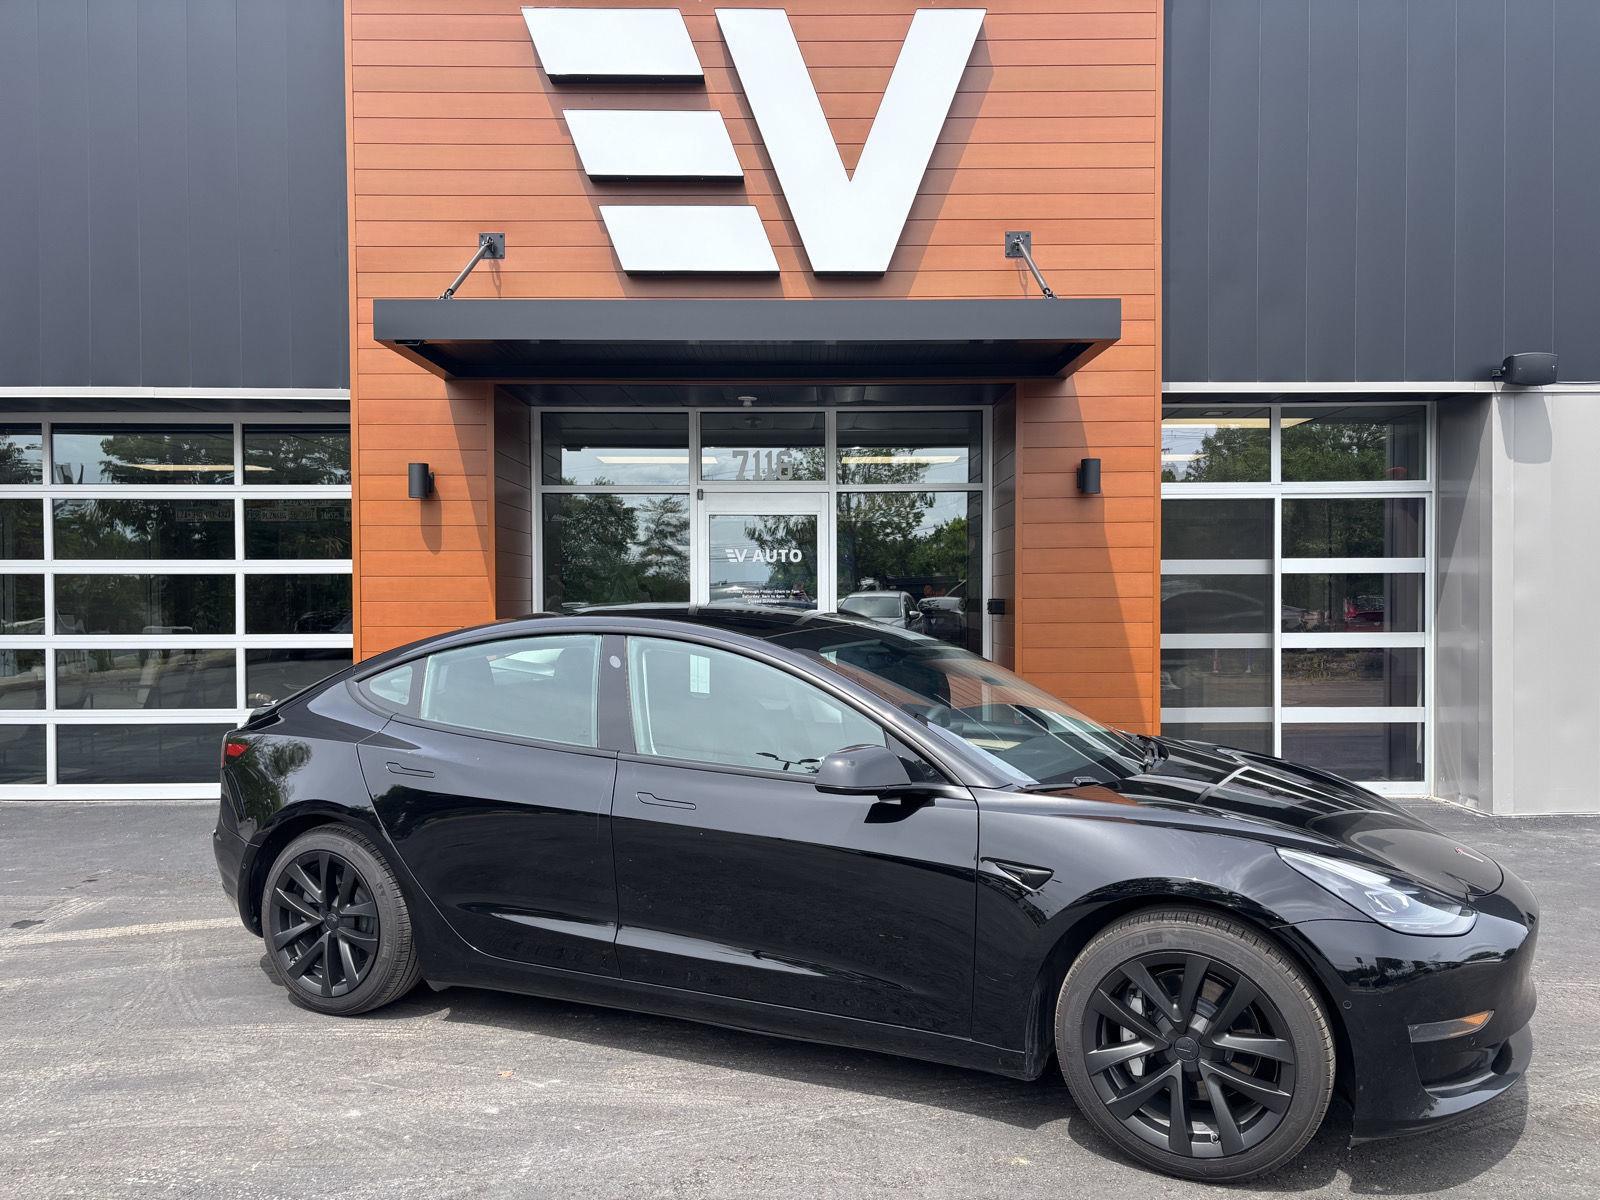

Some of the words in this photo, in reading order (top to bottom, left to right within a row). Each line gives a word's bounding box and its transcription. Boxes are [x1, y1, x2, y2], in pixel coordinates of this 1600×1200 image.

[520, 7, 987, 275] EV
[732, 450, 793, 481] 7116
[752, 549, 803, 563] AUTO
